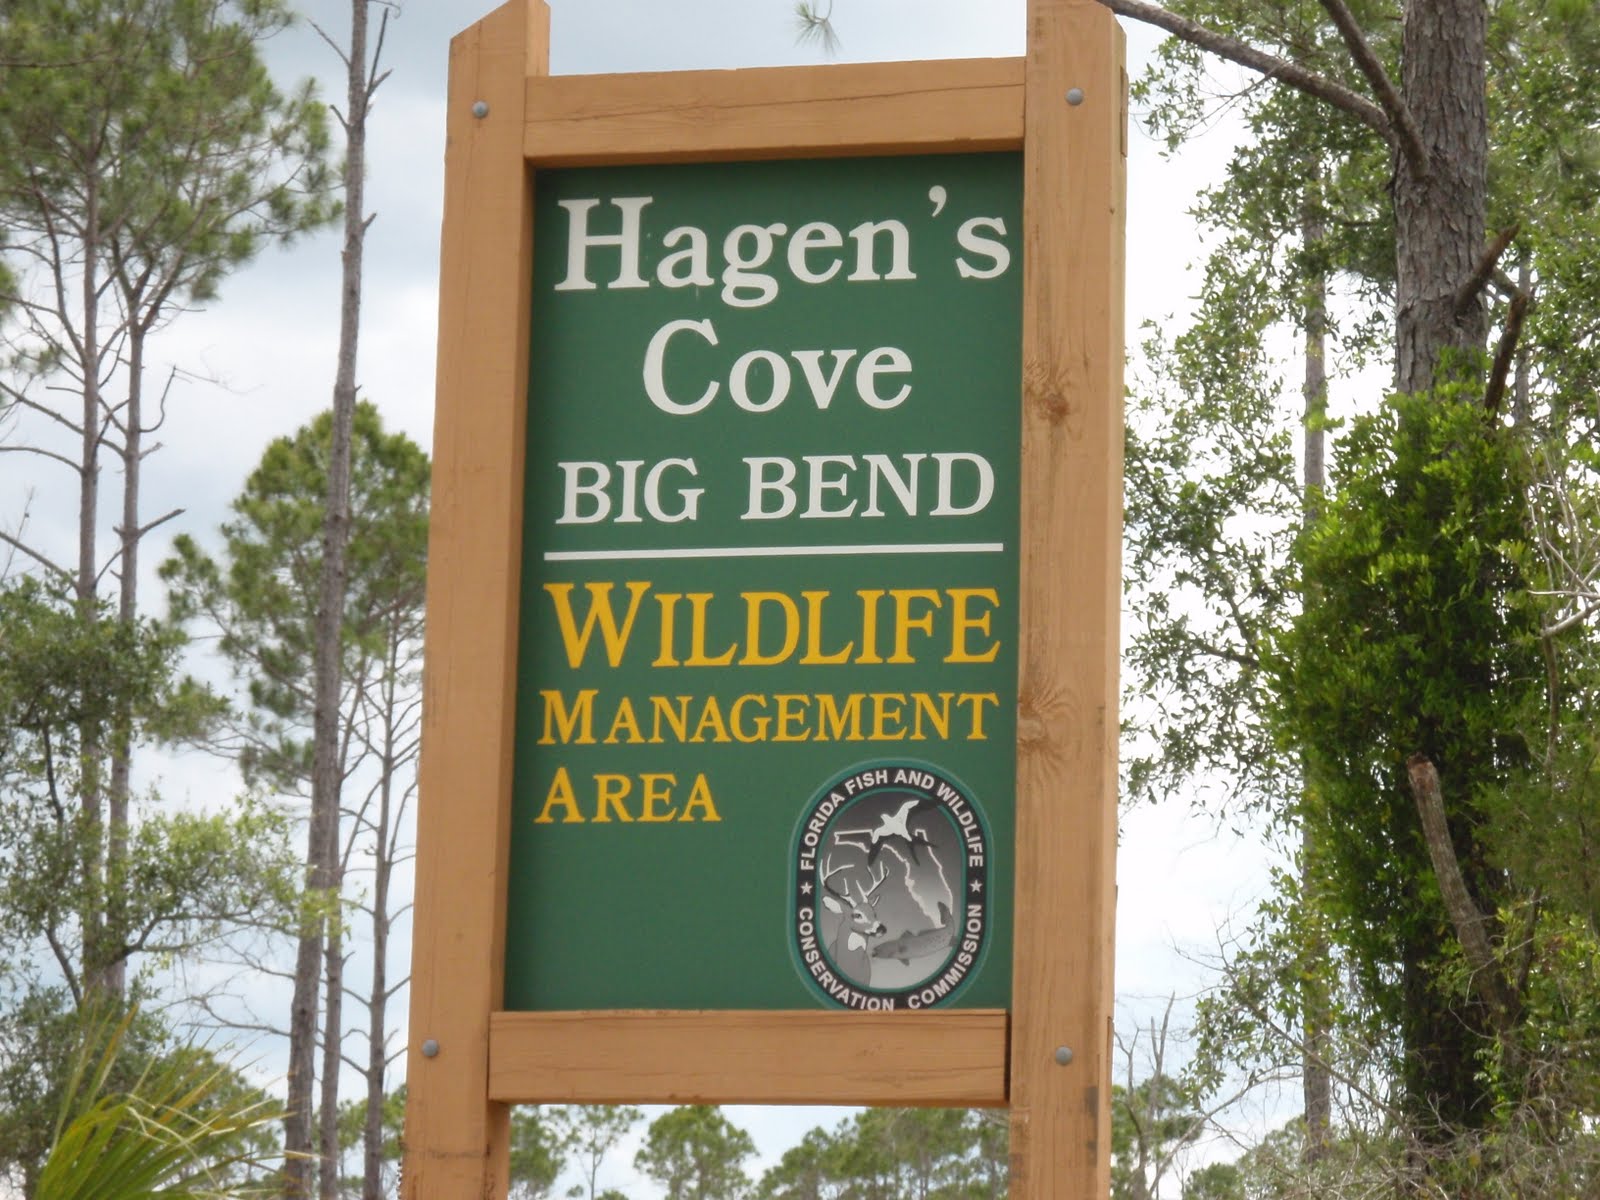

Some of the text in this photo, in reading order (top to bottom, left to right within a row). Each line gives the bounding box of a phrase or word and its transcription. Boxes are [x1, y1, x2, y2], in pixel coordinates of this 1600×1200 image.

[555, 186, 1011, 309] Hagen's
[642, 318, 913, 416] Cove
[556, 452, 995, 525] BIG BEND
[543, 580, 1001, 669] WILDLIFE
[538, 689, 1000, 745] MANAGEMENT
[535, 767, 722, 824] AREA
[800, 769, 984, 871] FLORIDA FISH AND WILDLIFE
[799, 904, 982, 1011] CONSERVATION COMMISSION
